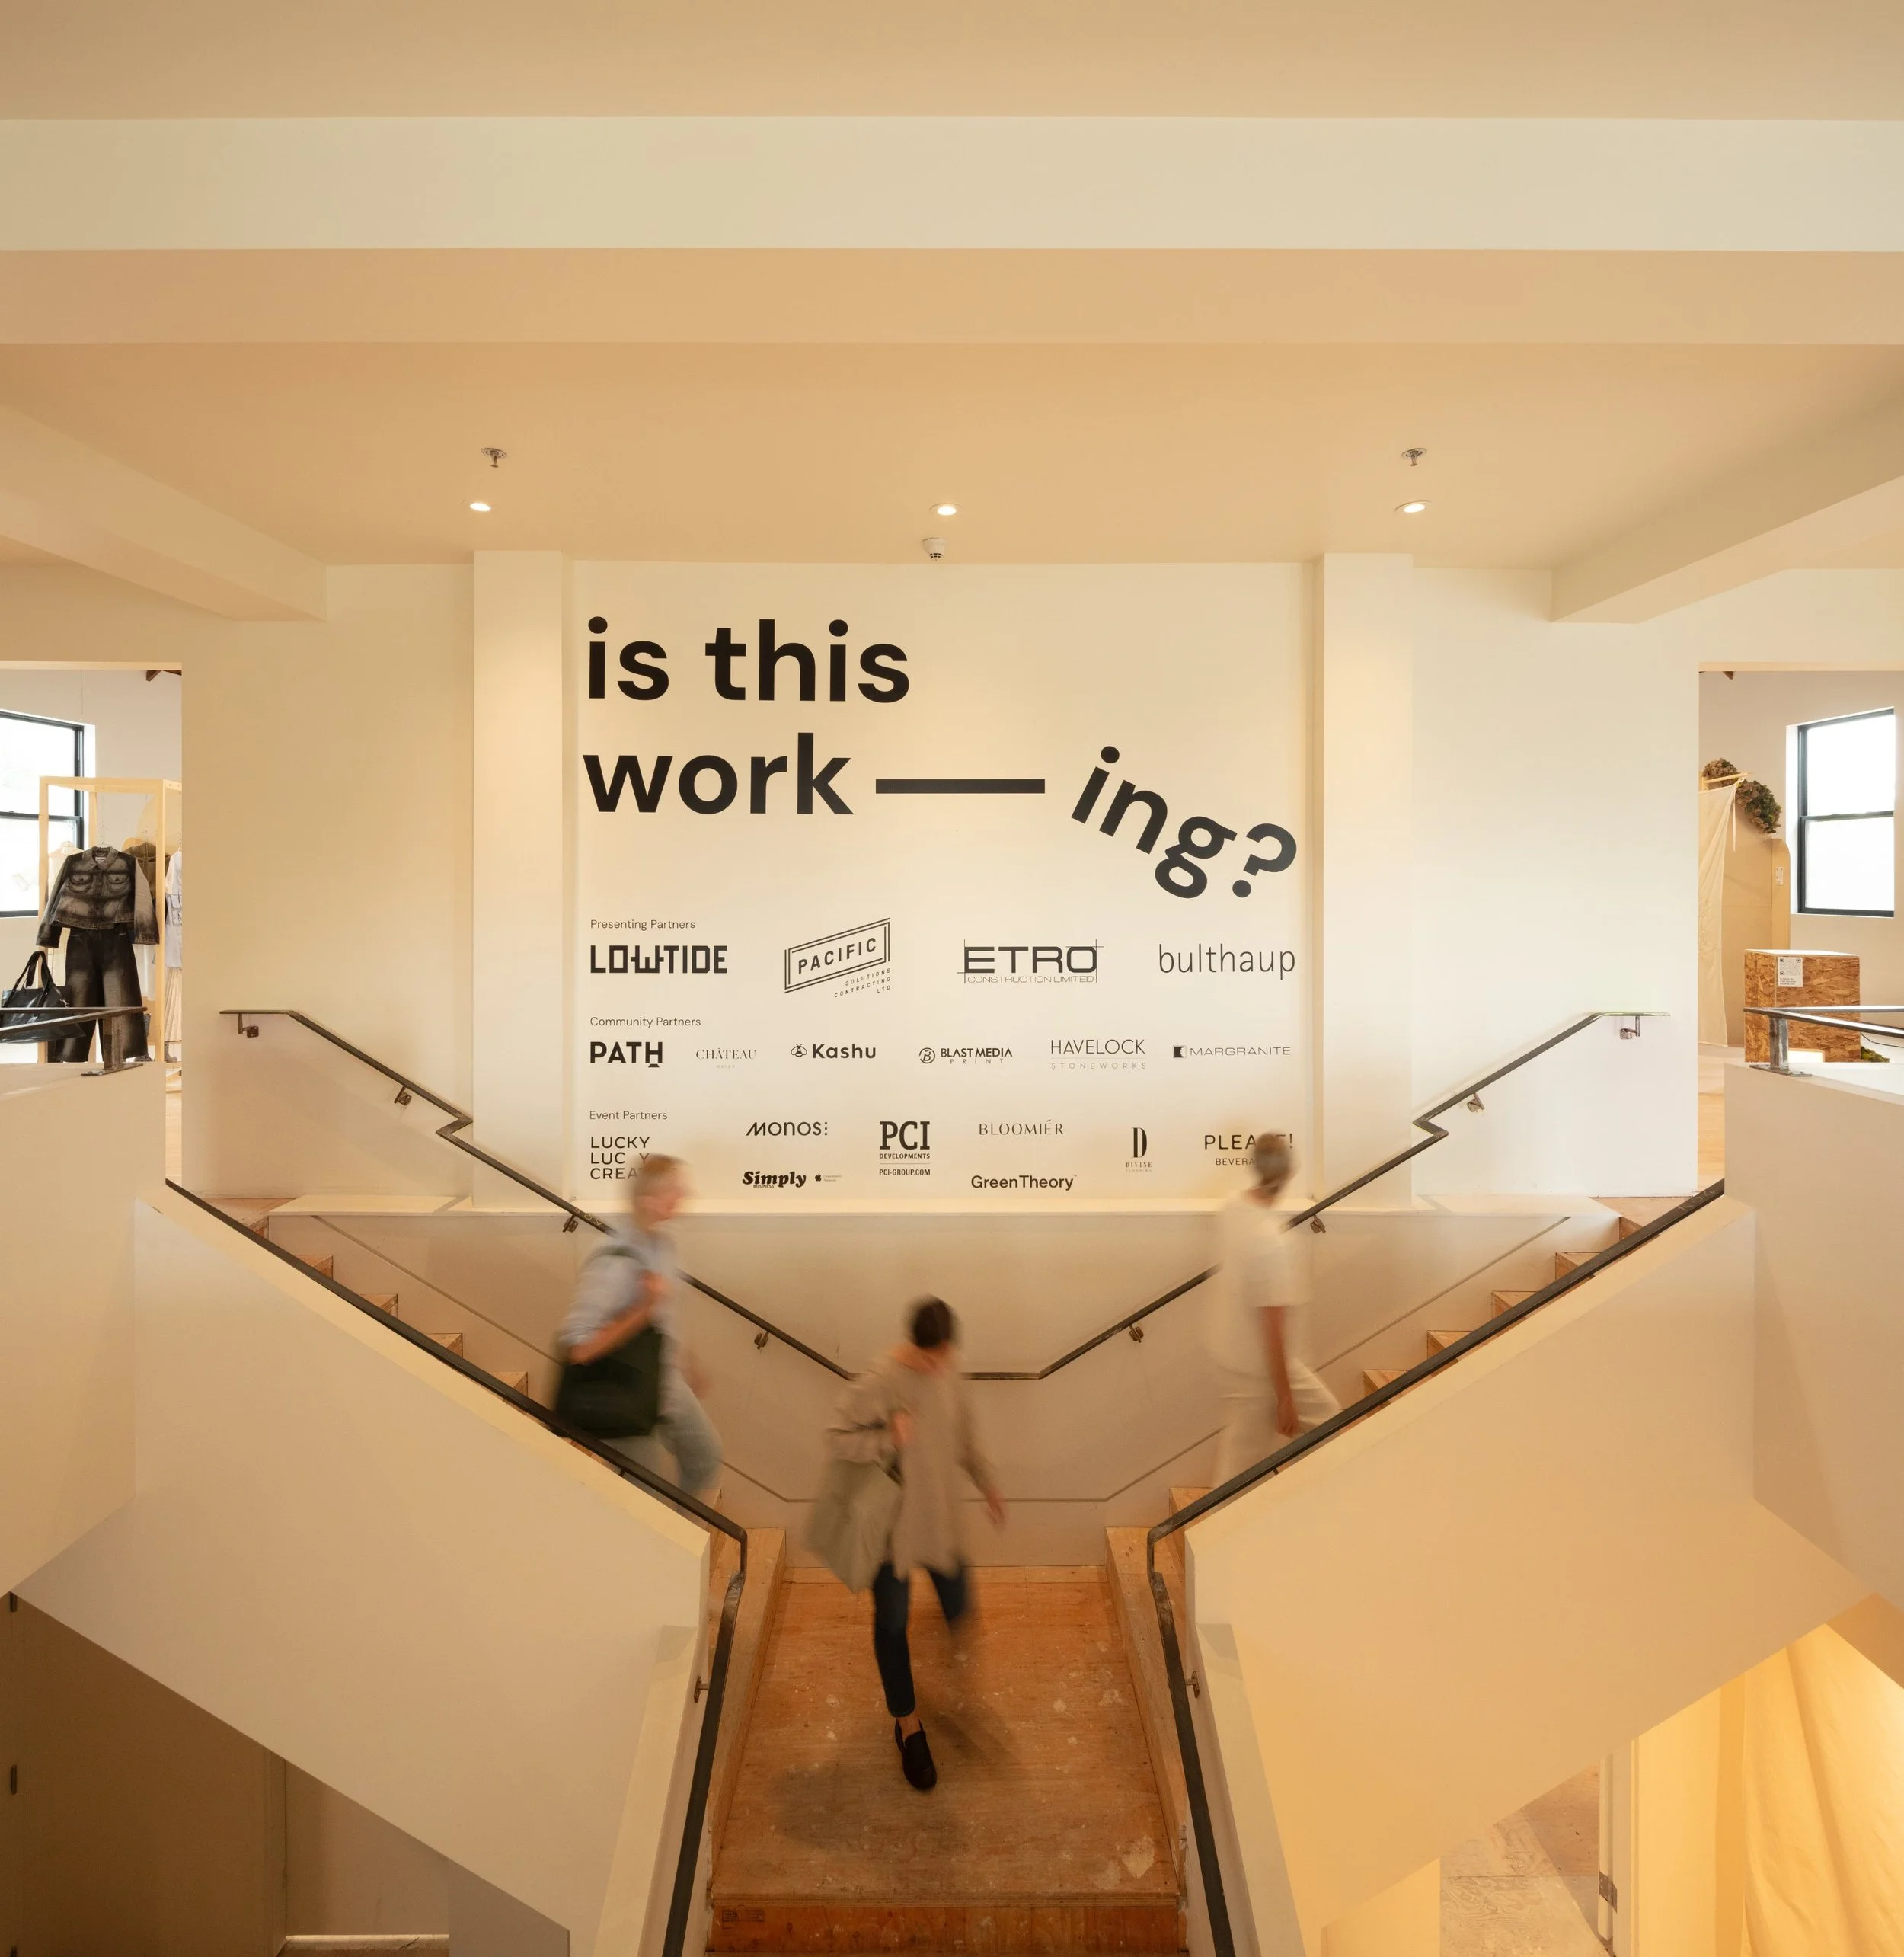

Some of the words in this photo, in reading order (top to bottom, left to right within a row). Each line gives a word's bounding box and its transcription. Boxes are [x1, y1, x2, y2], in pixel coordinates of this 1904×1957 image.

[588, 616, 669, 700] is
[705, 619, 909, 703] this
[583, 732, 854, 814] work
[1071, 746, 1296, 898] ing?
[591, 919, 647, 931] Presenting
[651, 920, 695, 929] Partners
[591, 945, 727, 974] LOWTIDE
[798, 937, 877, 974] PACIFIC
[964, 946, 1097, 974] ETRO
[1159, 944, 1295, 980] bulthaup
[845, 967, 891, 986] SOLUTIONS
[834, 977, 891, 998] CONTRACTING
[877, 985, 891, 993] LTD
[590, 1017, 653, 1028] Community
[656, 1017, 701, 1026] Partners
[590, 1041, 663, 1067] PATH
[813, 1044, 876, 1058] Kashu
[941, 1048, 973, 1057] BLAST
[976, 1048, 1013, 1057] MEDIA
[1052, 1039, 1145, 1054] HAVELOCK
[1190, 1047, 1291, 1056] MARGRANITE
[590, 1111, 619, 1119] Event
[624, 1111, 667, 1119] Partners
[880, 1121, 930, 1150] PCI
[979, 1120, 1063, 1135] BLOOMIÉR
[591, 1137, 650, 1149] LUCKY
[590, 1152, 650, 1165] LUCY
[742, 1171, 807, 1188] Simply
